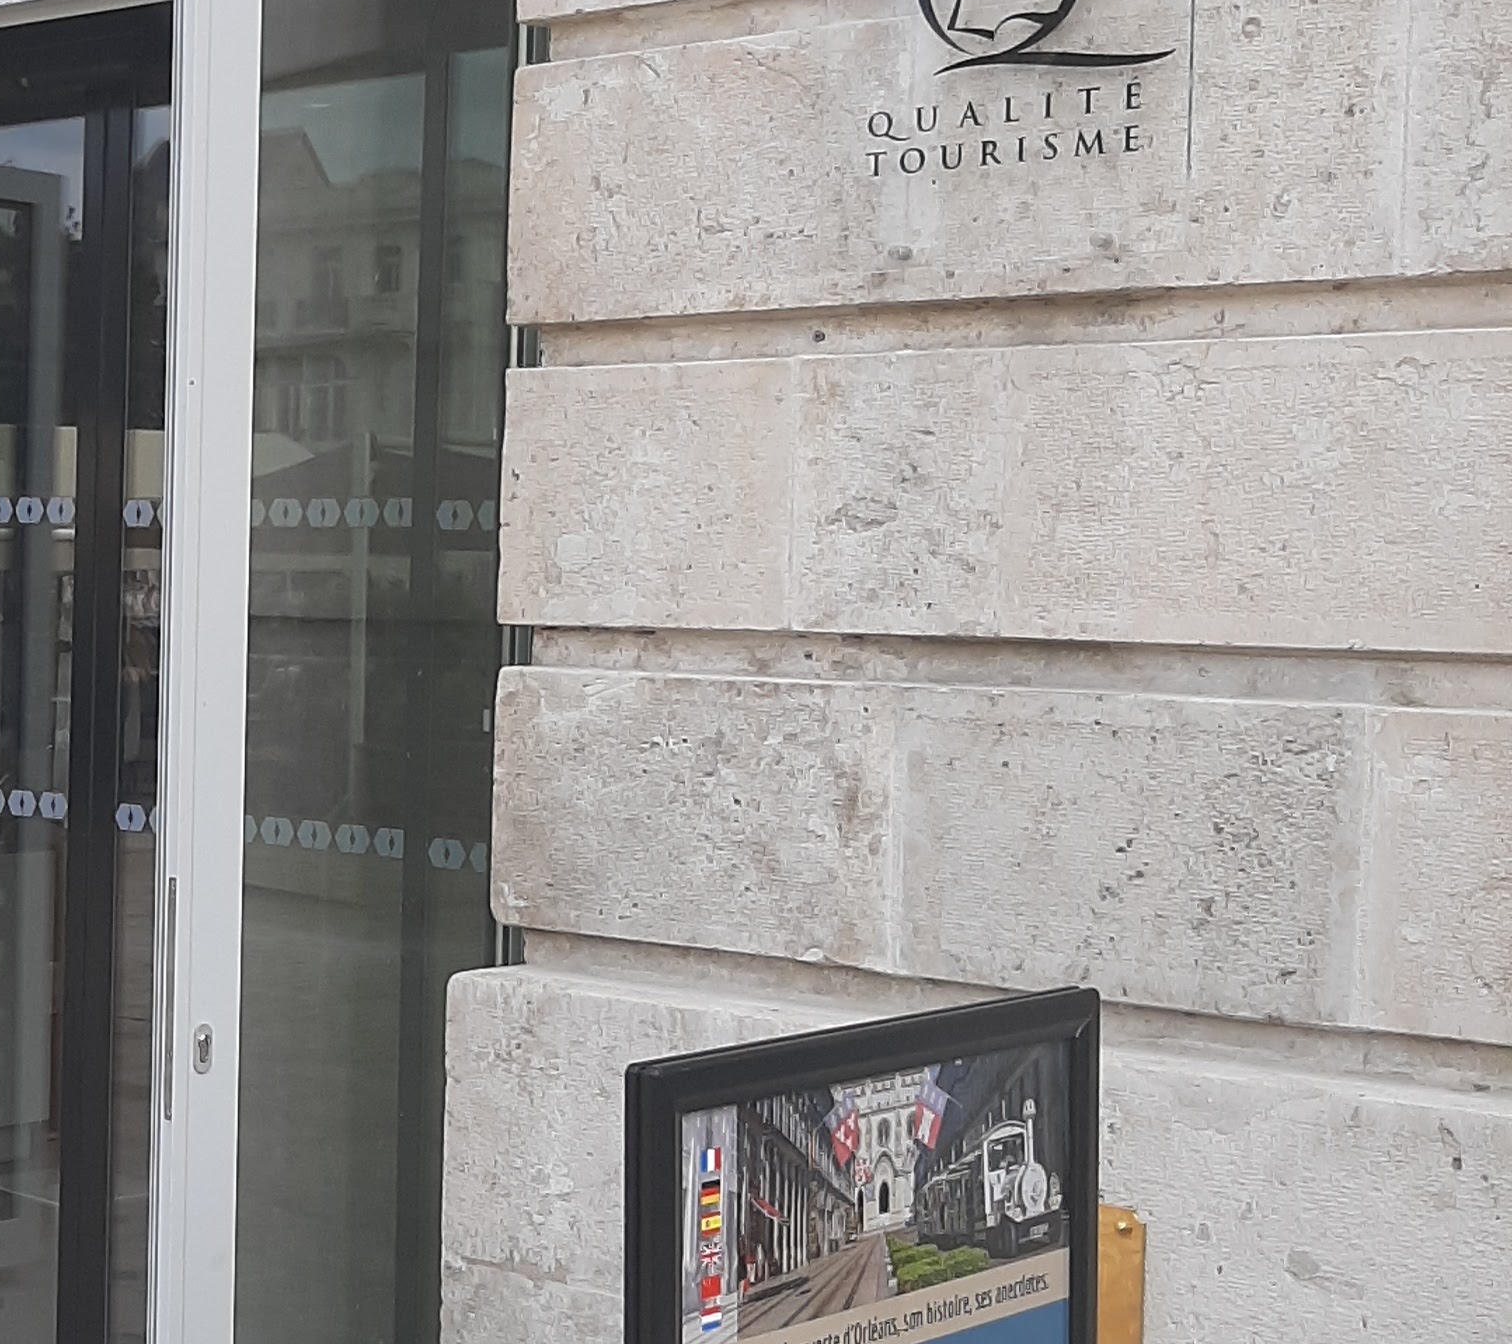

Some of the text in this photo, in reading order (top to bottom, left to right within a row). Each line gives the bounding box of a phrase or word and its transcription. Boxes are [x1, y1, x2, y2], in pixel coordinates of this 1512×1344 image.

[866, 76, 1143, 142] QUALITÉ
[865, 124, 1143, 178] TOURISME
[904, 1310, 924, 1331] son
[926, 1293, 973, 1325] histoire,
[975, 1289, 993, 1310] ses
